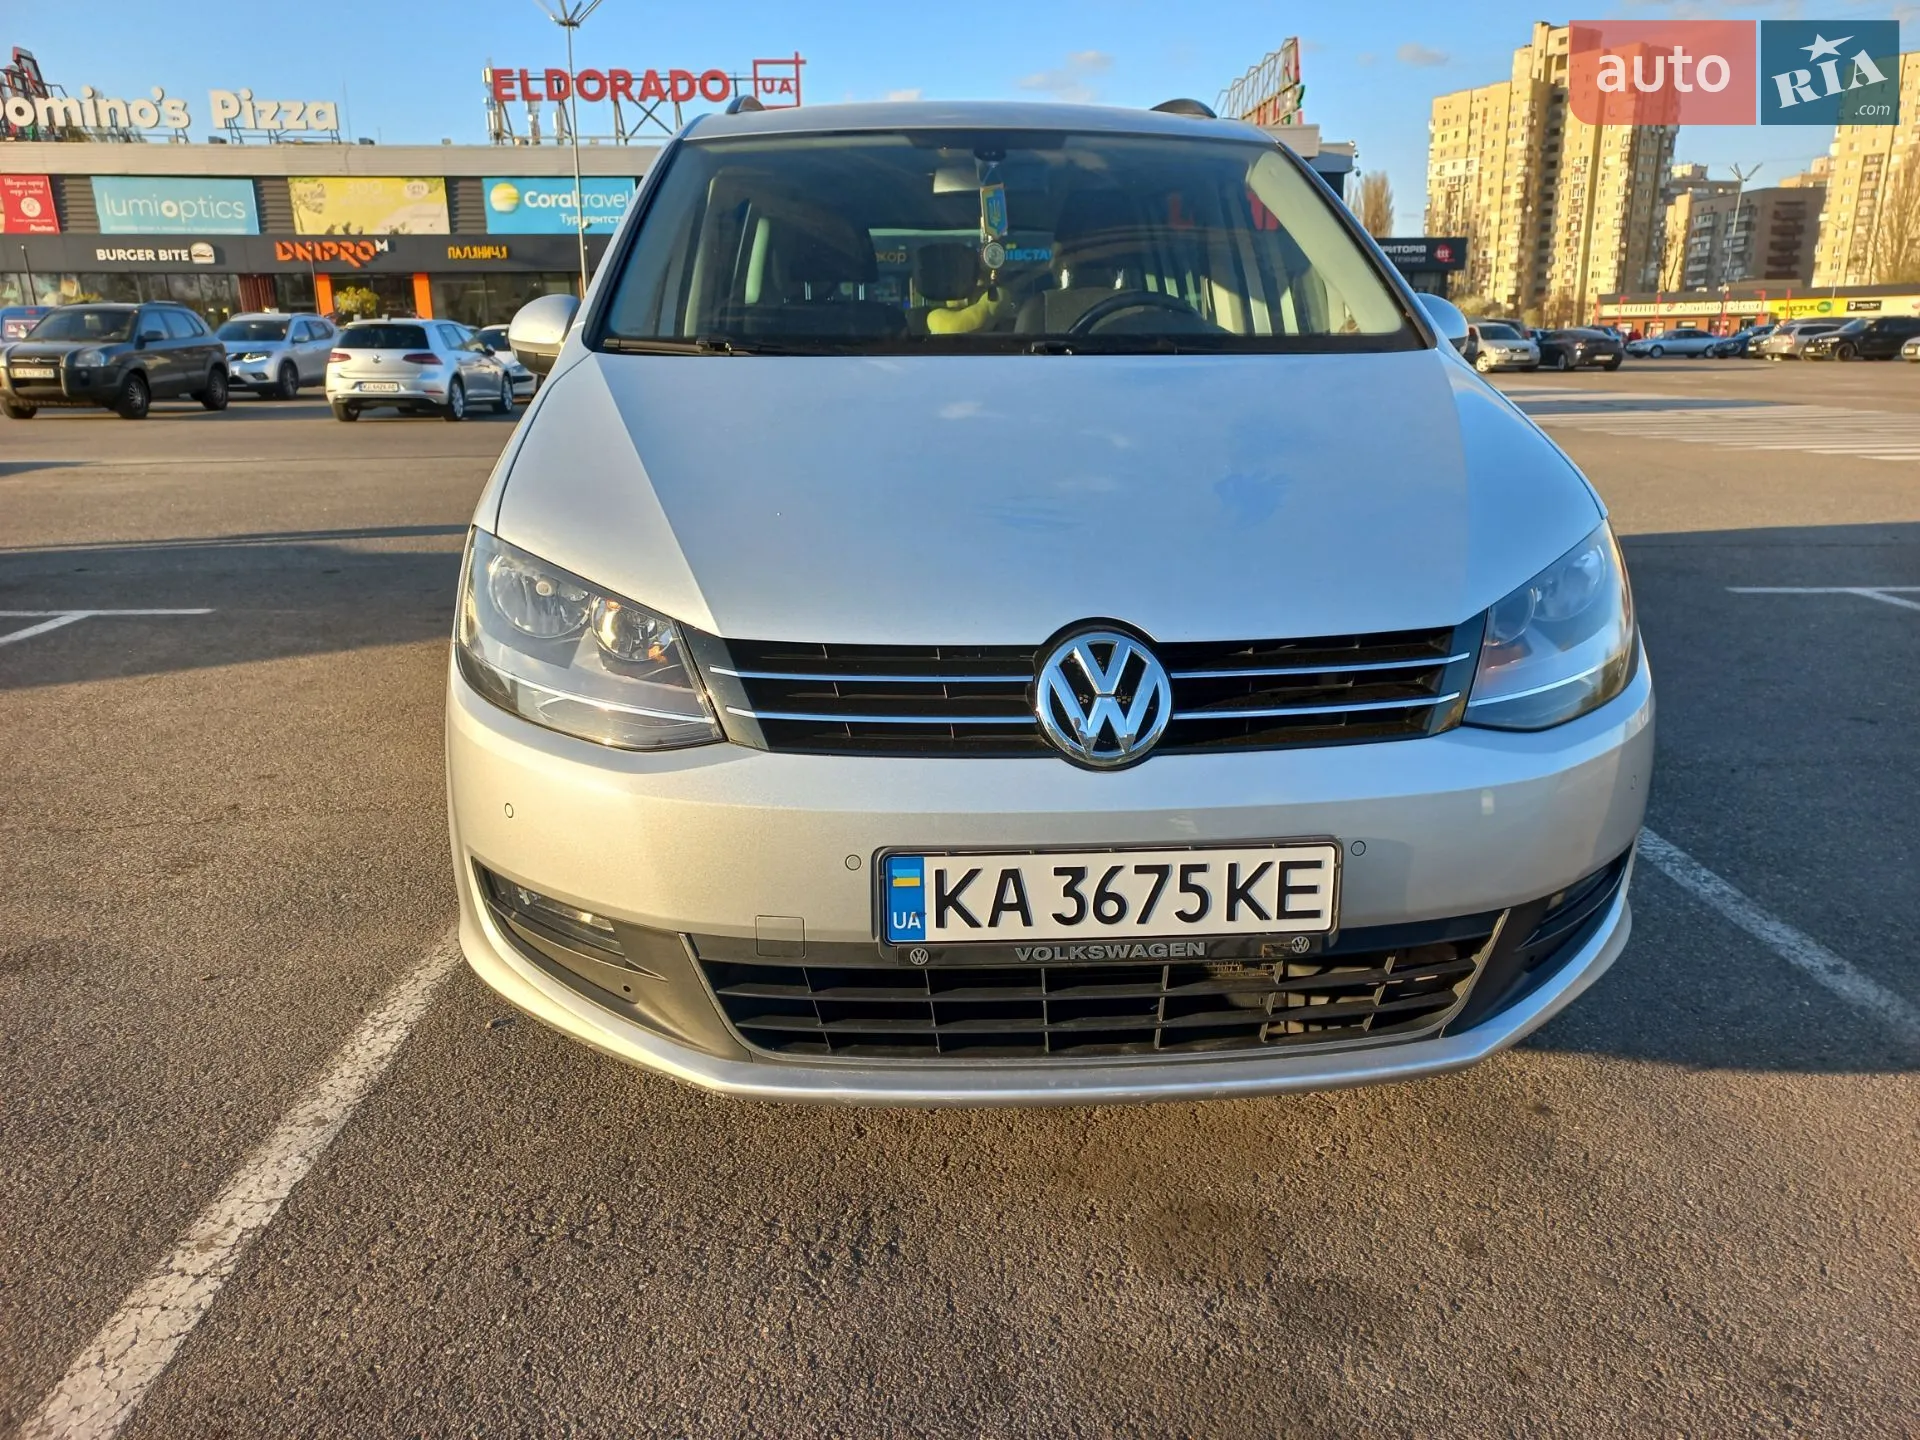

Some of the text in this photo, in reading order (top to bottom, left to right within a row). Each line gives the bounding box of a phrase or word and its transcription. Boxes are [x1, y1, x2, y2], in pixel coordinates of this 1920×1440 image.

[492, 68, 793, 102] ELDORADO UA
[0, 84, 339, 131] omino's Pizza
[104, 192, 246, 223] lumioptics
[96, 249, 190, 262] BURGER BITE
[893, 860, 1324, 929] UA KA 3675 KE
[1015, 942, 1206, 962] VOLKSWAGEN
